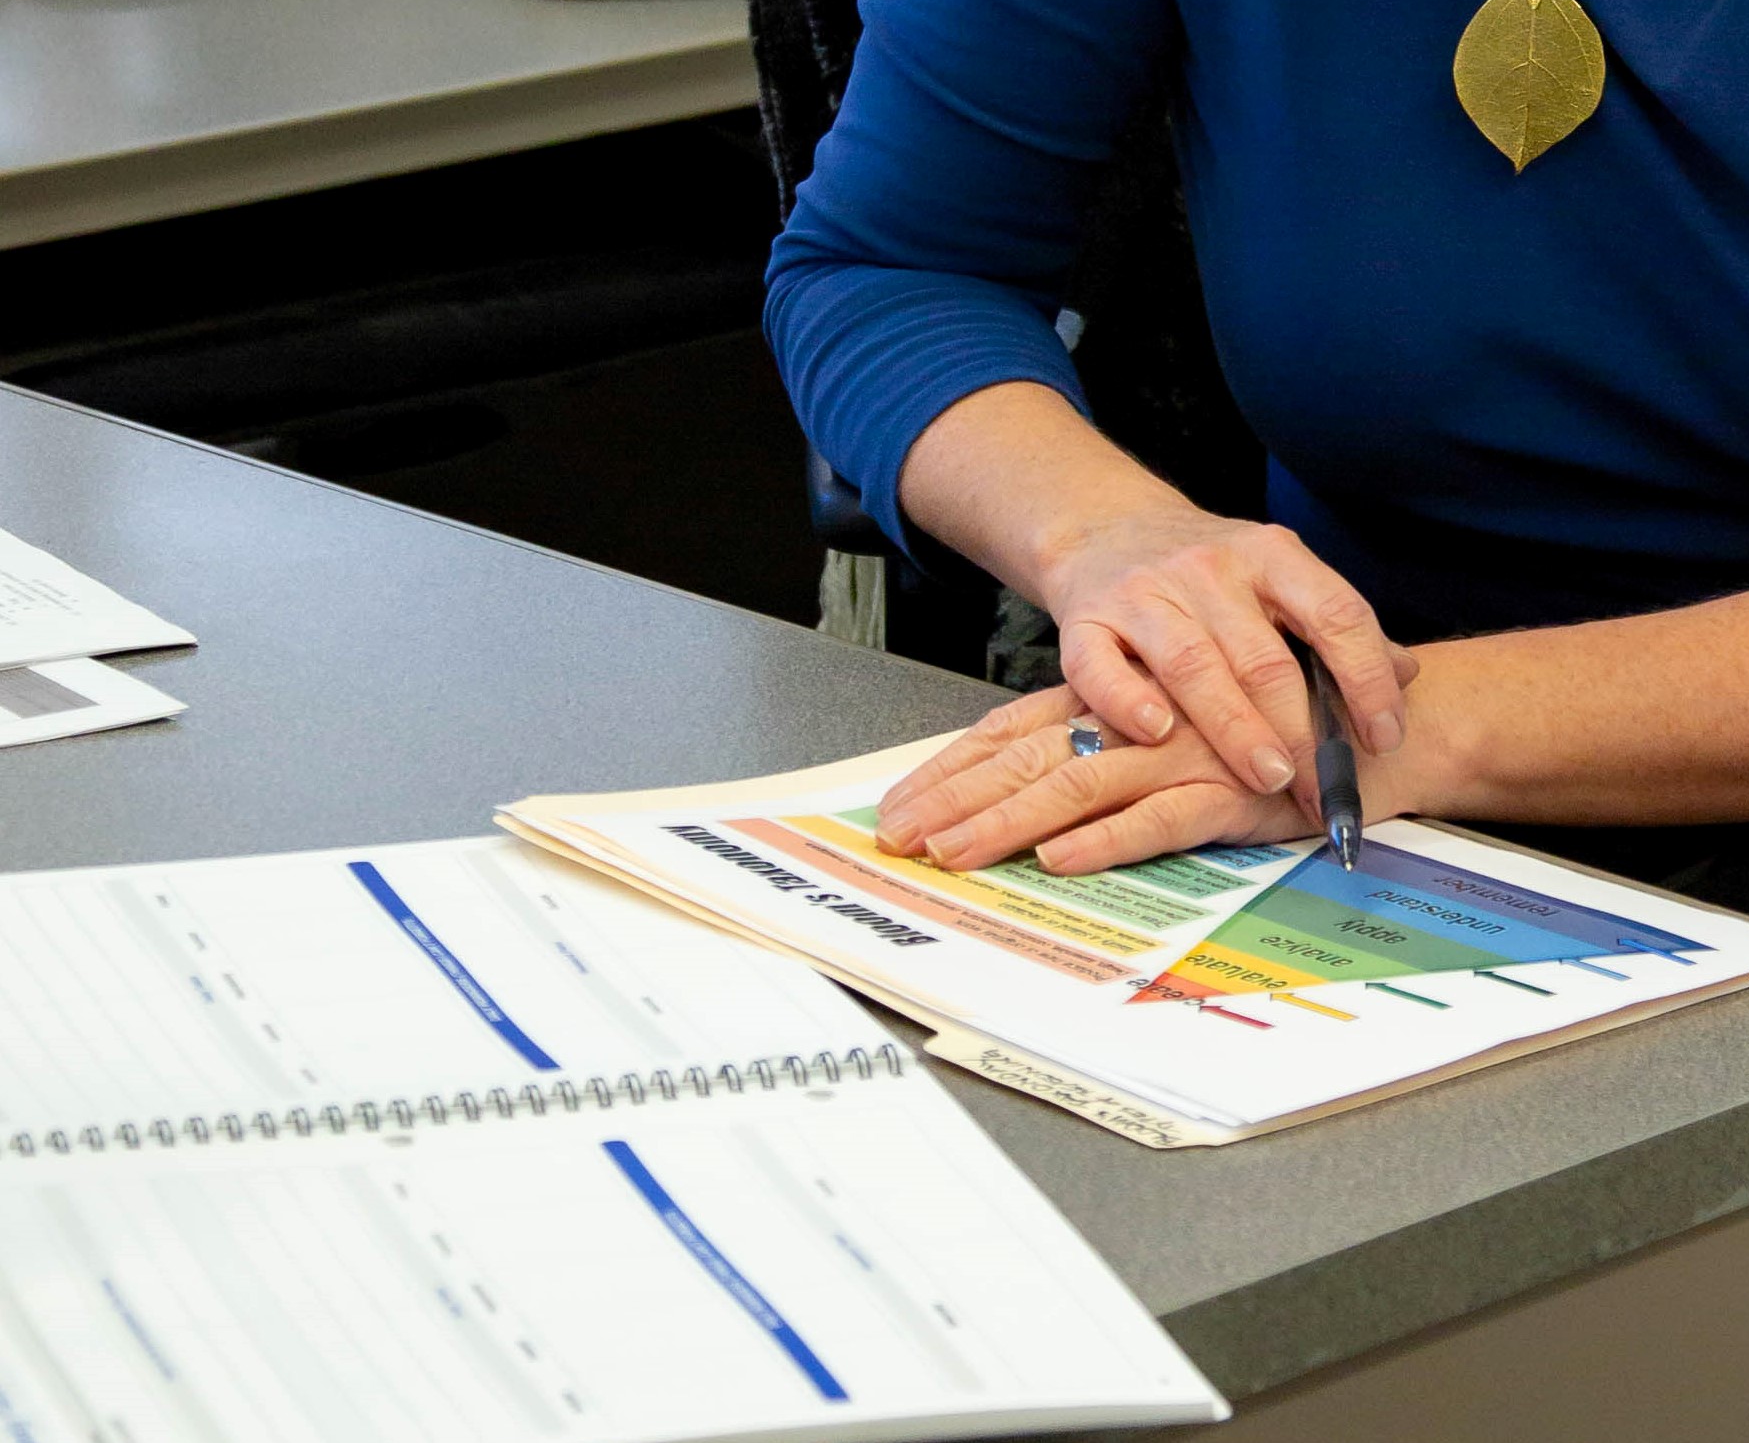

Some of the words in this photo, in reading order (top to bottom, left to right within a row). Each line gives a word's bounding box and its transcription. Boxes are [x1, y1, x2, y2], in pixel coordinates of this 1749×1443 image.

[658, 823, 820, 894] Taxonomy
[1367, 889, 1506, 937] understand
[1432, 871, 1561, 918] remember
[805, 887, 940, 948] Bloom's
[1334, 914, 1407, 945] apply
[1182, 952, 1289, 992] evaluate
[1258, 933, 1354, 968] analyze
[1126, 976, 1205, 1011] create
